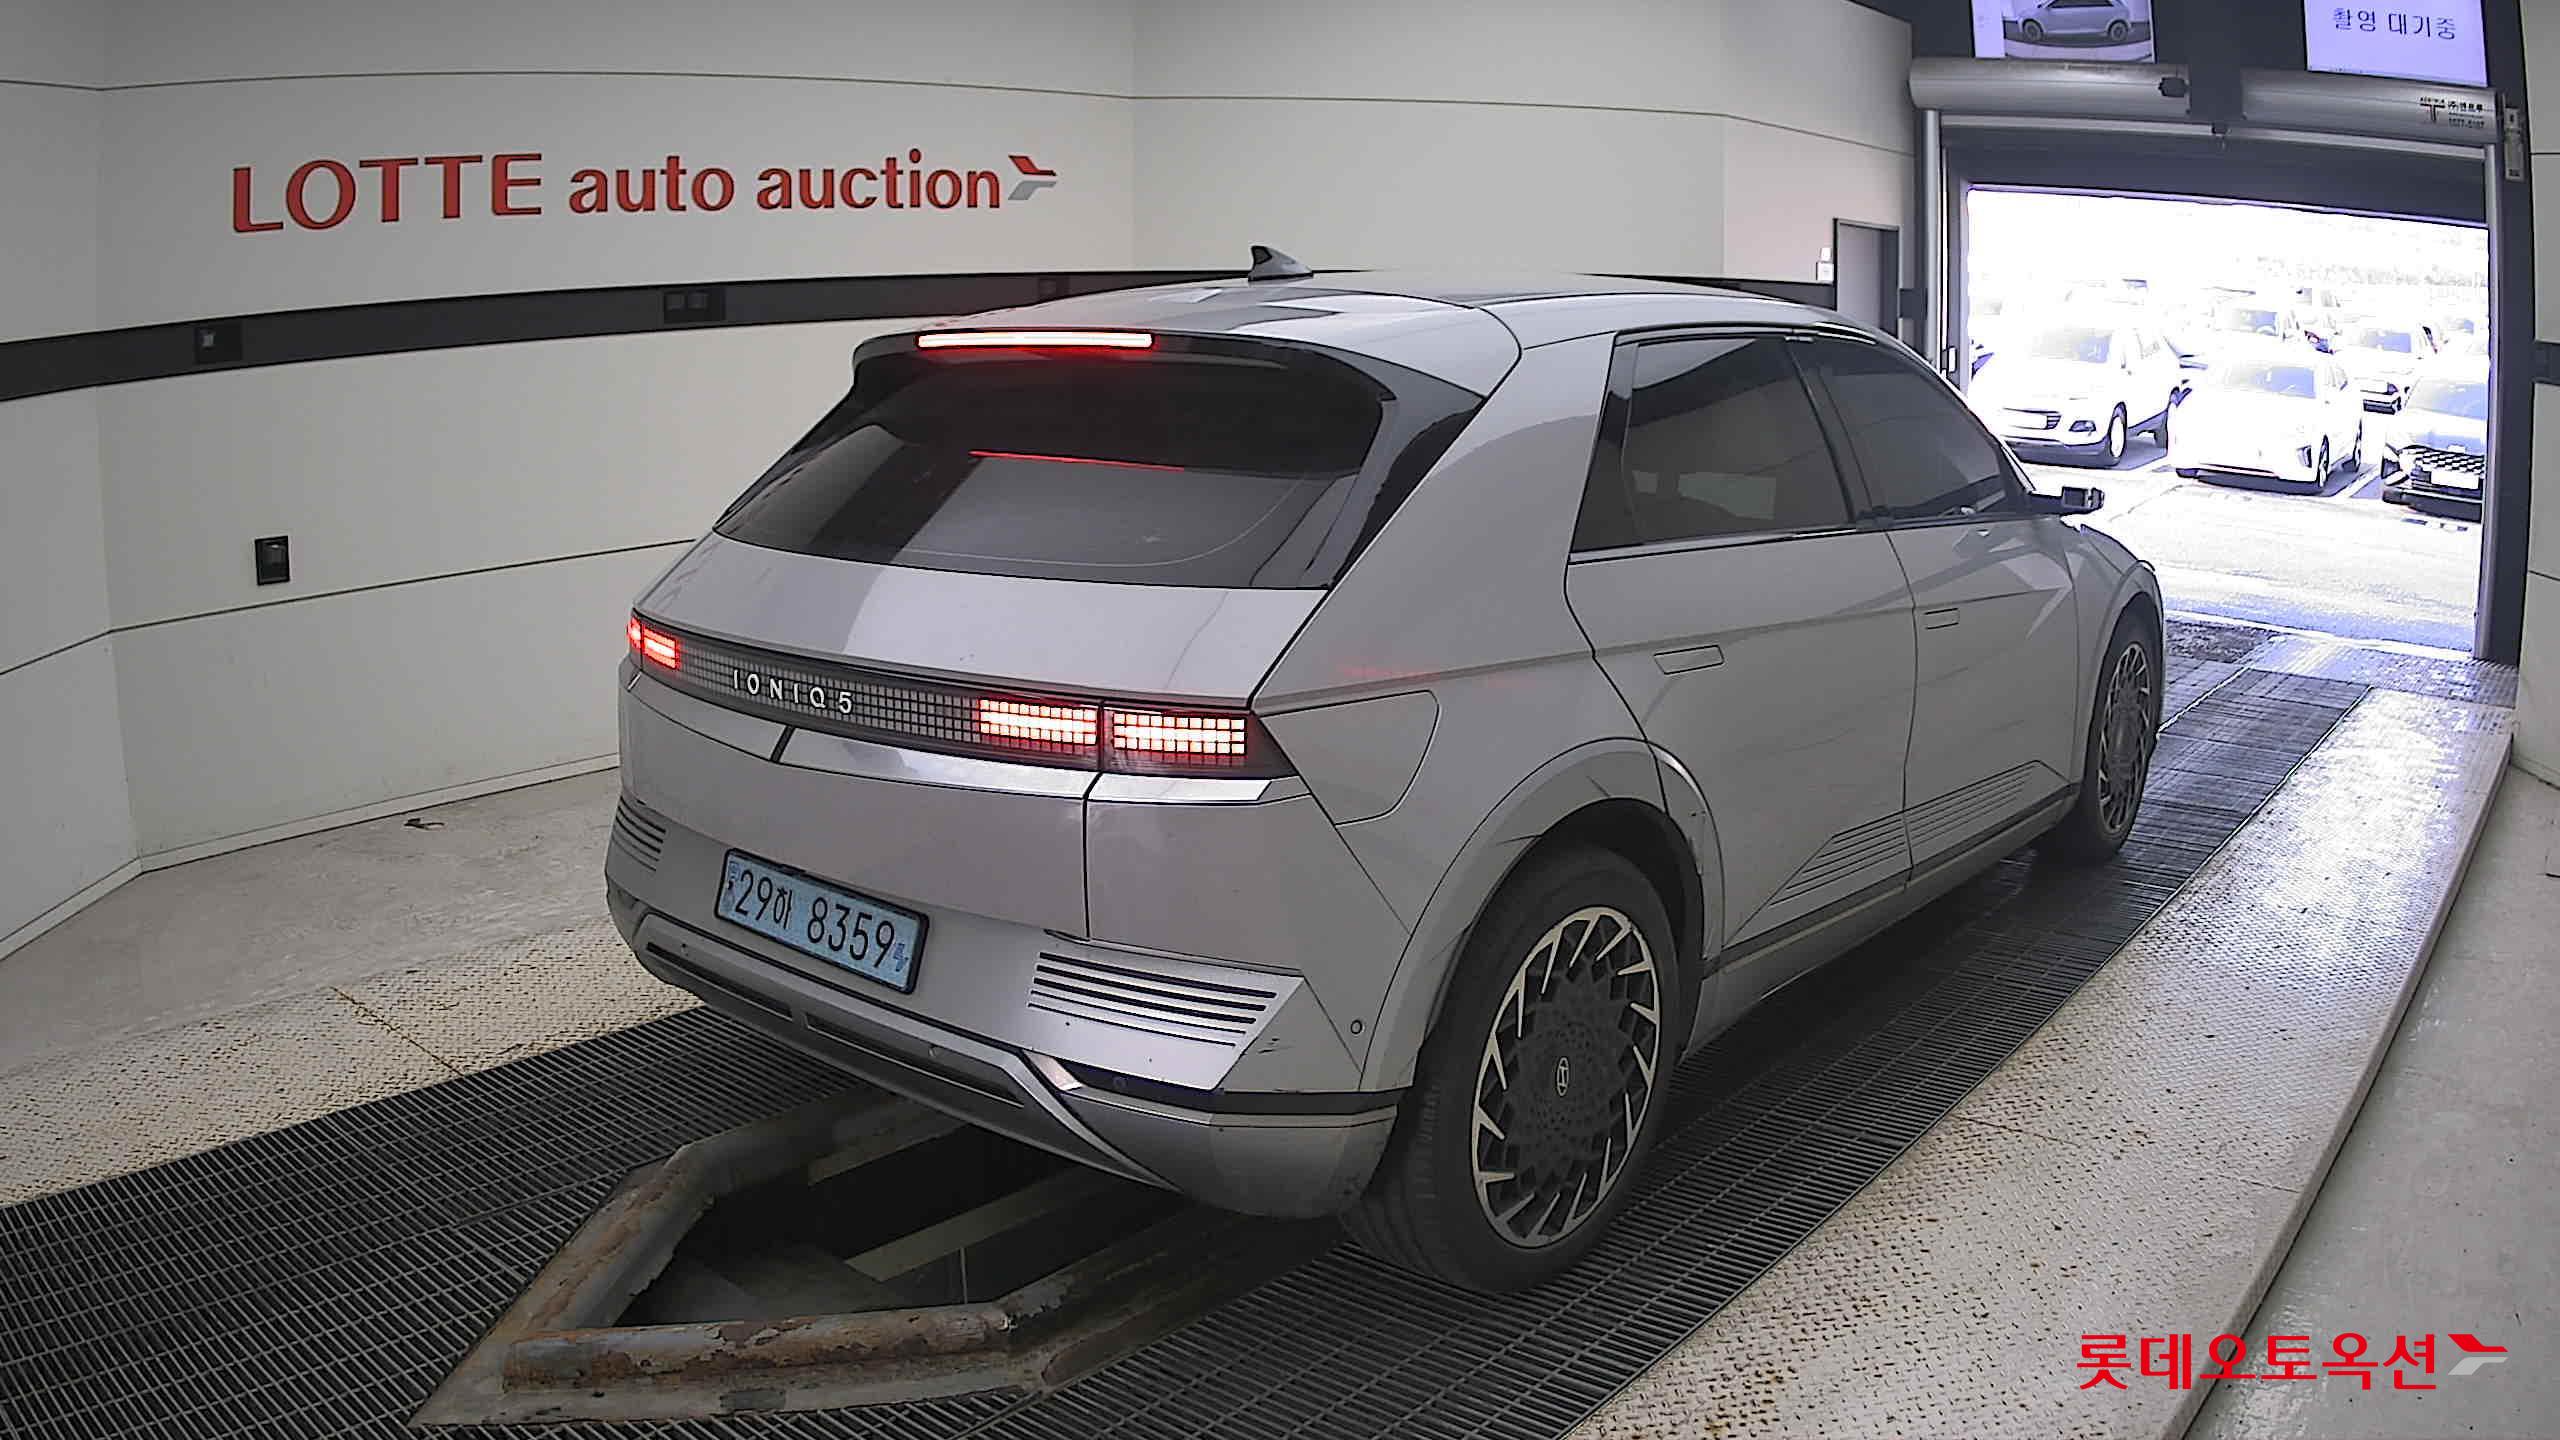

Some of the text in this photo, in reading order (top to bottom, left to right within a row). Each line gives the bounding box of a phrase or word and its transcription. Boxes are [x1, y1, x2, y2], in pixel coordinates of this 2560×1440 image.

[2334, 8, 2456, 40] 촬영 대기중
[231, 148, 1002, 233] LOTTE auto auction
[735, 869, 793, 930] 29하
[807, 896, 896, 968] 8359
